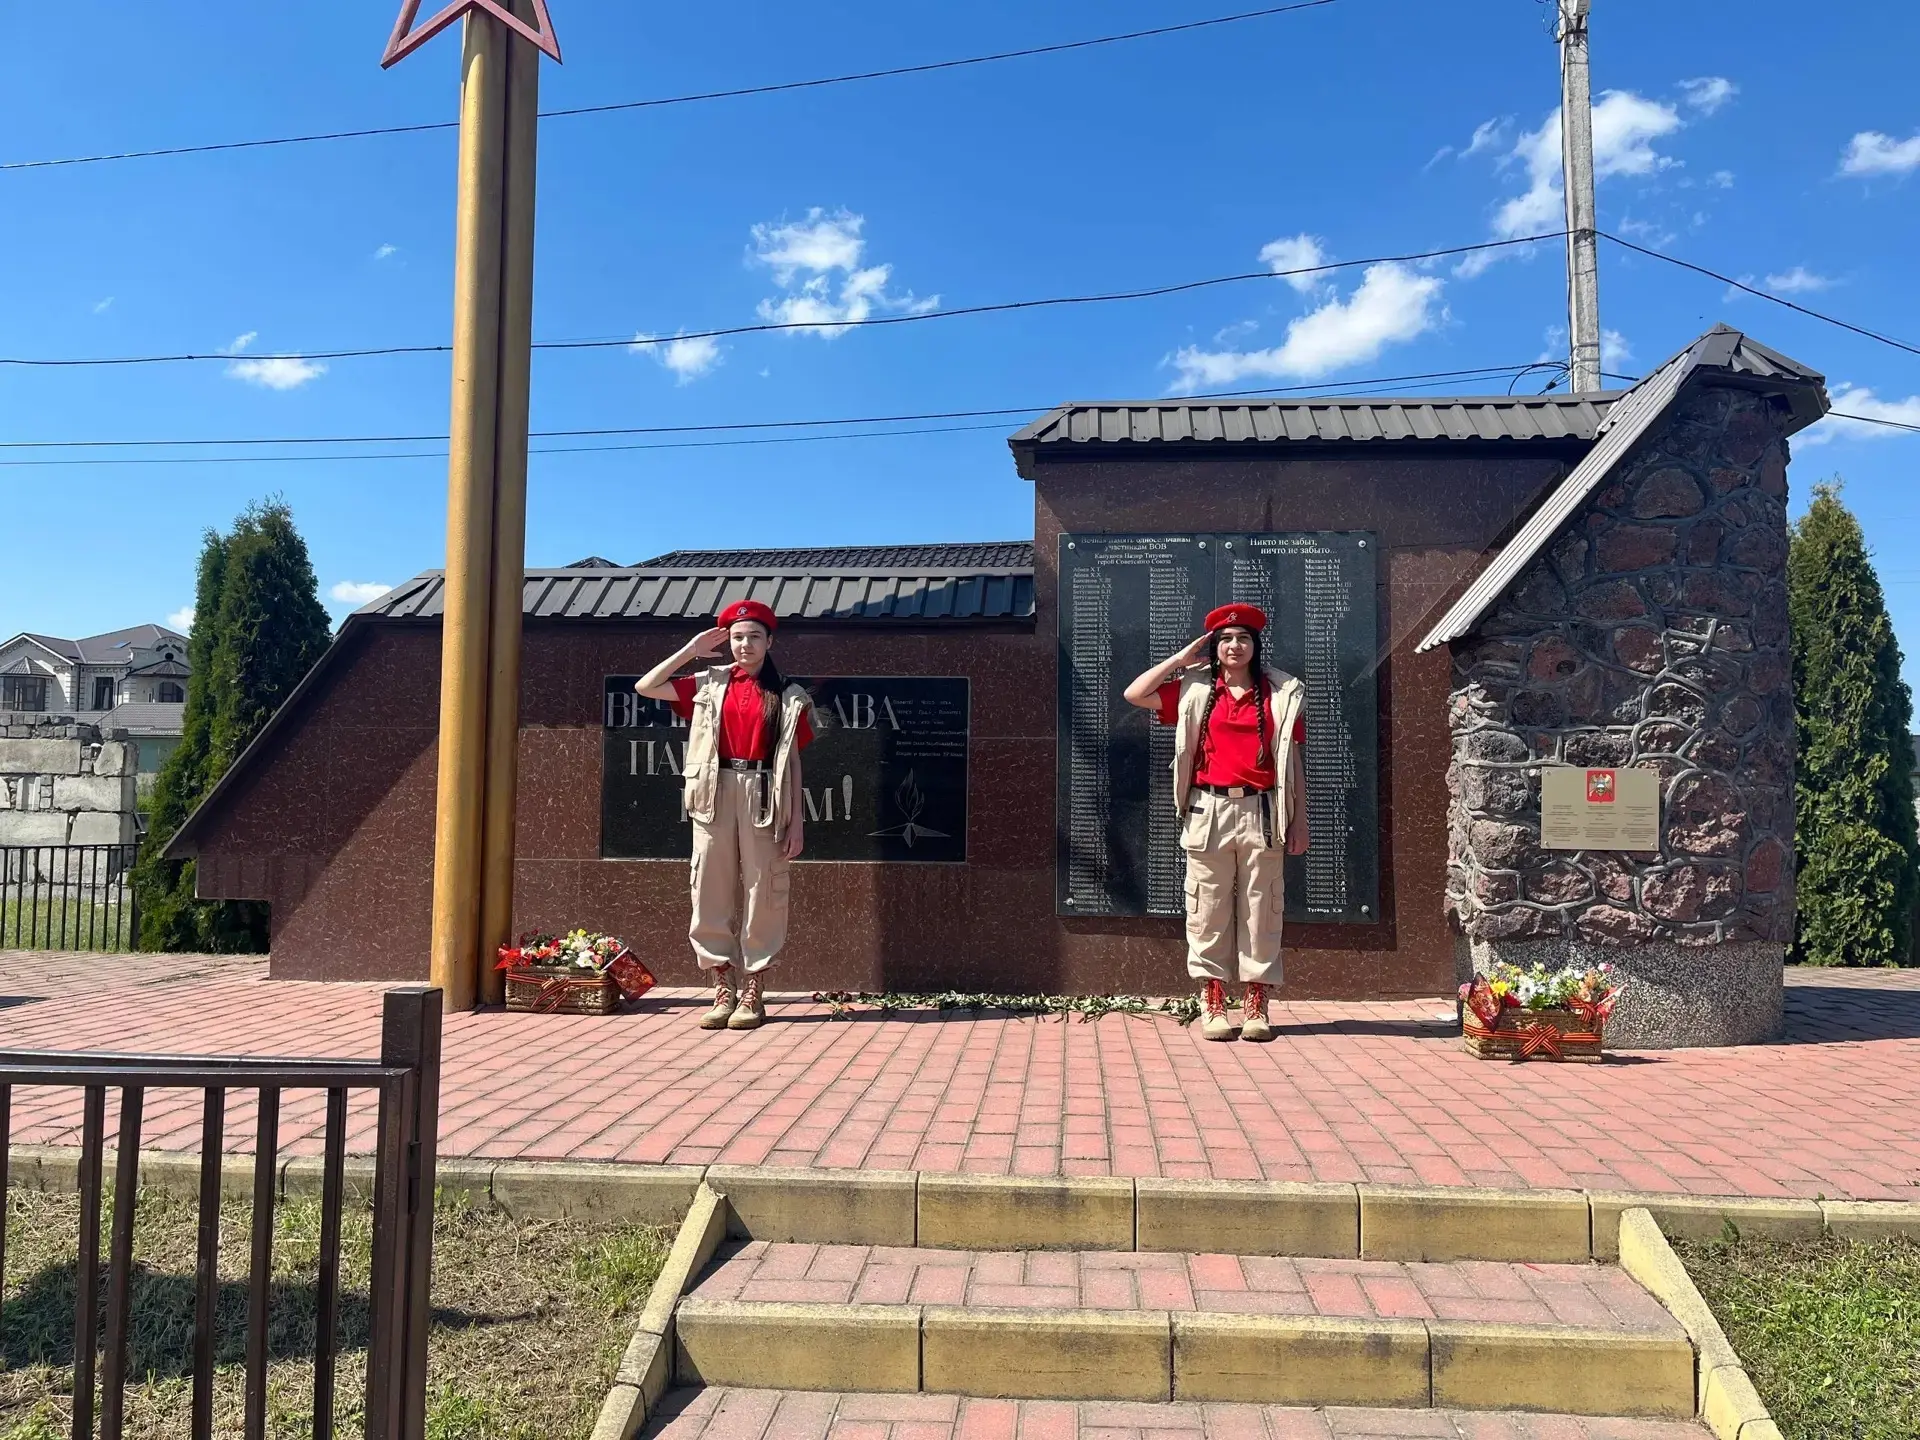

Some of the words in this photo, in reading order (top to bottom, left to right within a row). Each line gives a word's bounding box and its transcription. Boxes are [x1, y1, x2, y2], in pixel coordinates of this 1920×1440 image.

[1250, 538, 1277, 546] Никто
[1290, 538, 1318, 546] забыт,
[606, 692, 687, 728] ВЕЧ
